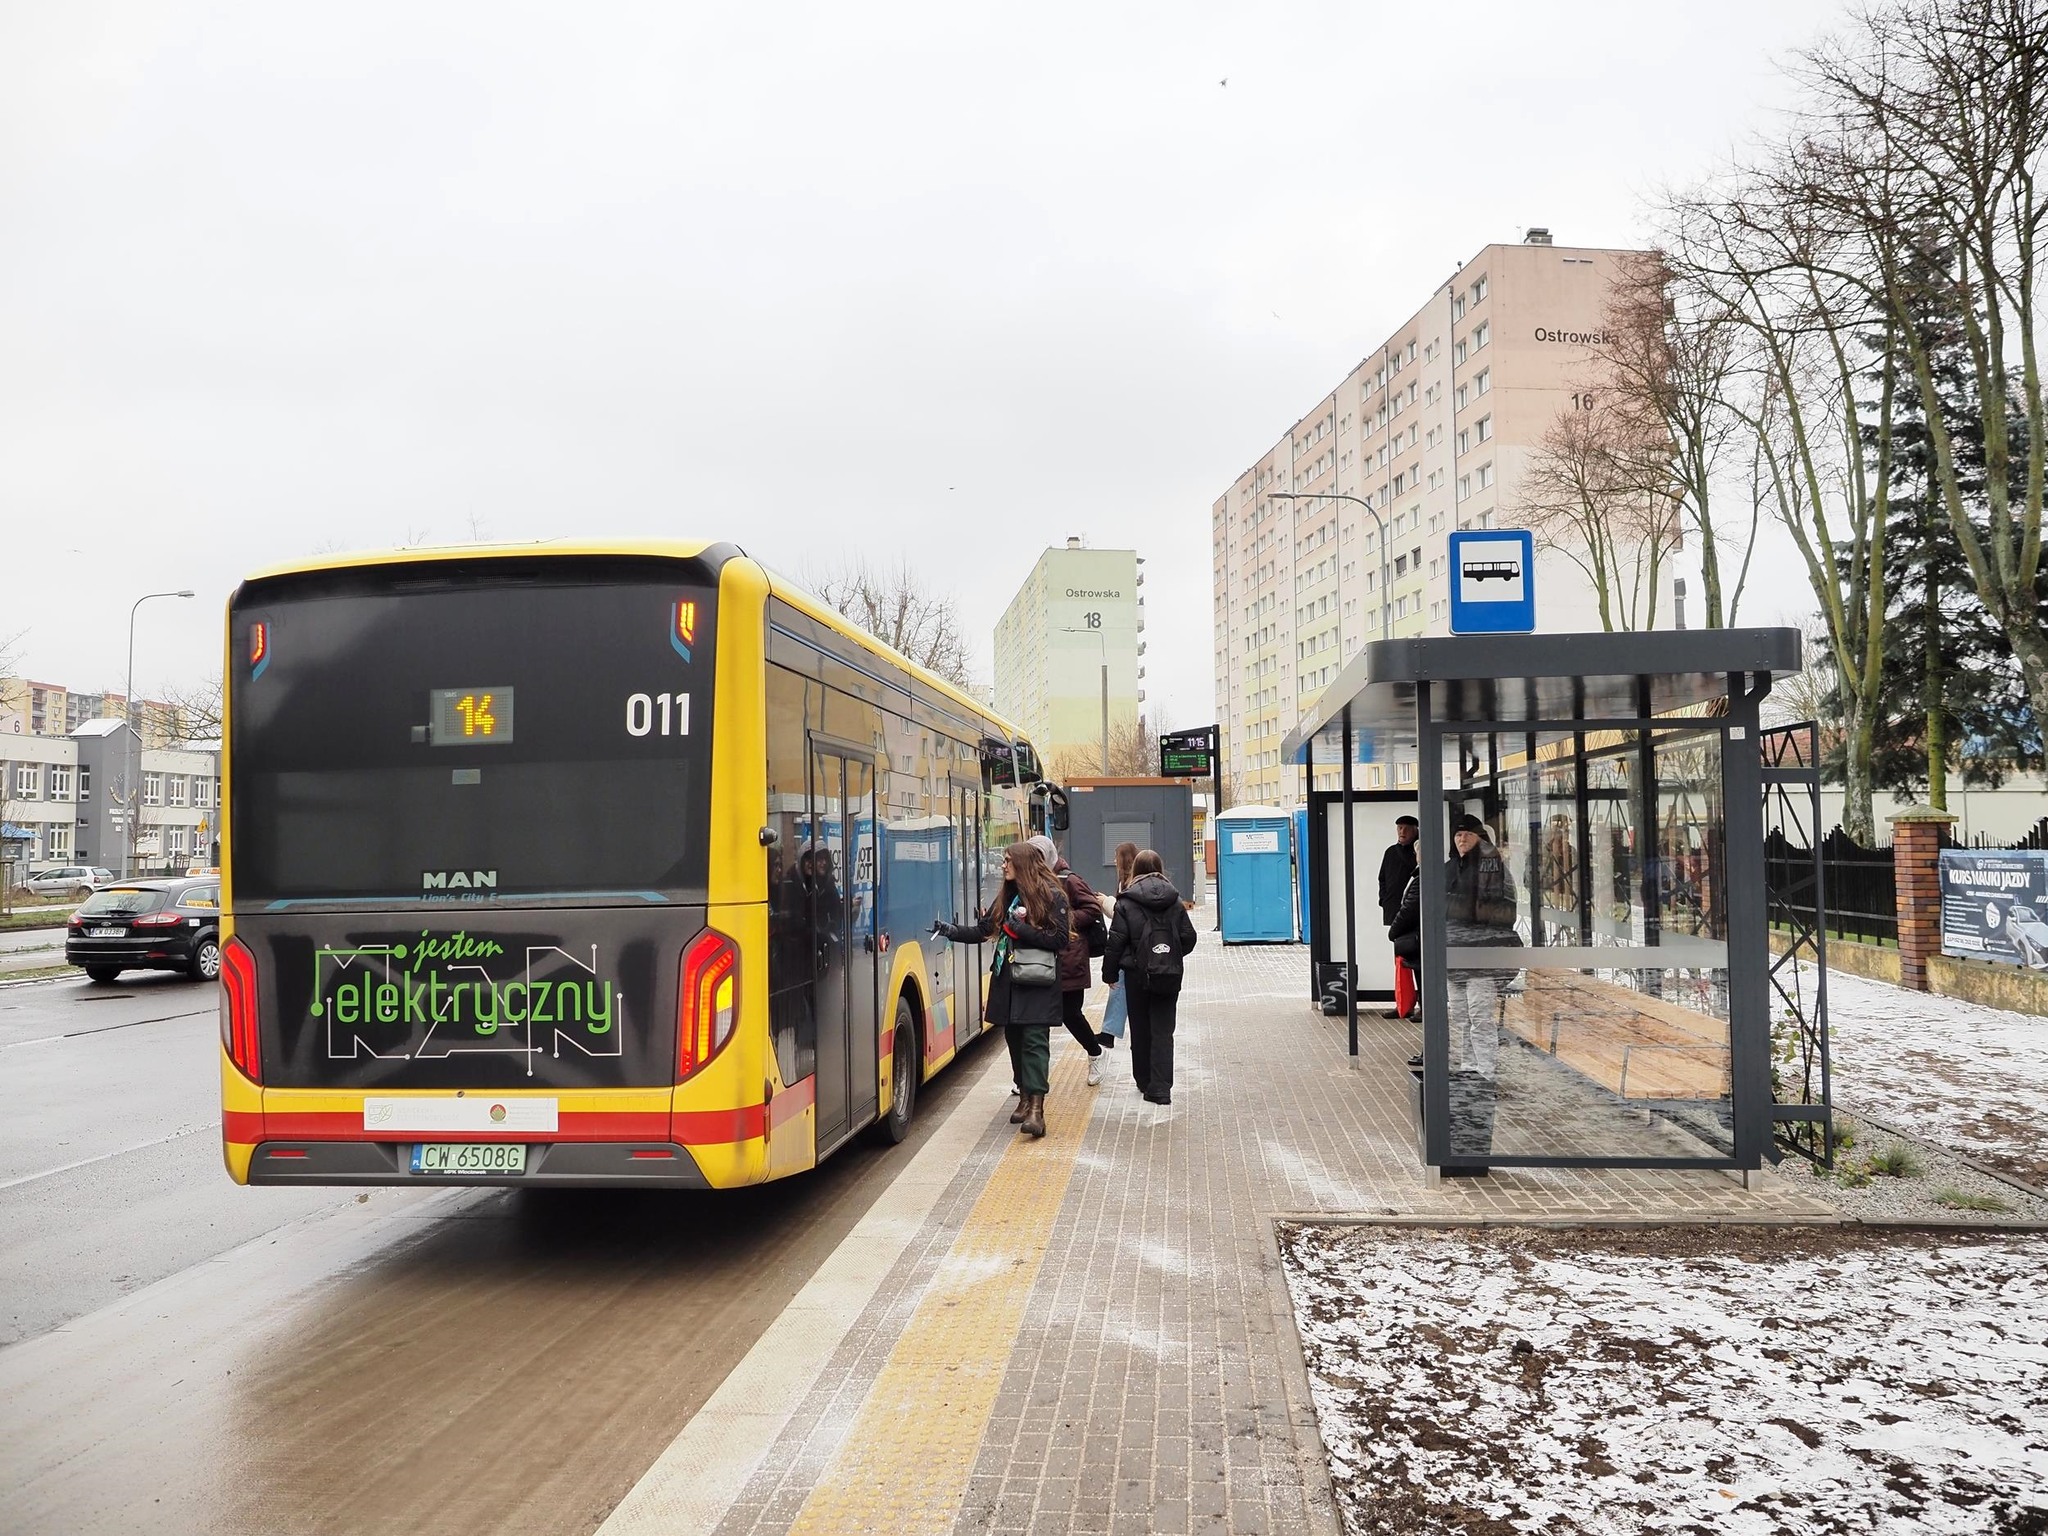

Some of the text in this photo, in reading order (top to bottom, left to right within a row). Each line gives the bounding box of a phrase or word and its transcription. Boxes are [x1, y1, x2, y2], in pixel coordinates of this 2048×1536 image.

[1535, 327, 1619, 344] Ostrowska
[1571, 394, 1594, 411] 16
[1065, 588, 1120, 598] Ostrowska
[1083, 612, 1102, 628] 18
[456, 695, 495, 735] 14
[626, 692, 690, 737] 011
[14, 720, 20, 733] 6
[423, 871, 497, 889] MAN
[1949, 869, 2031, 891] KURS NAUKI JAZDY
[421, 892, 497, 904] Lion's City E
[413, 930, 503, 973] jestem
[336, 970, 612, 1035] elektryczny
[425, 1147, 519, 1167] CW 6508G
